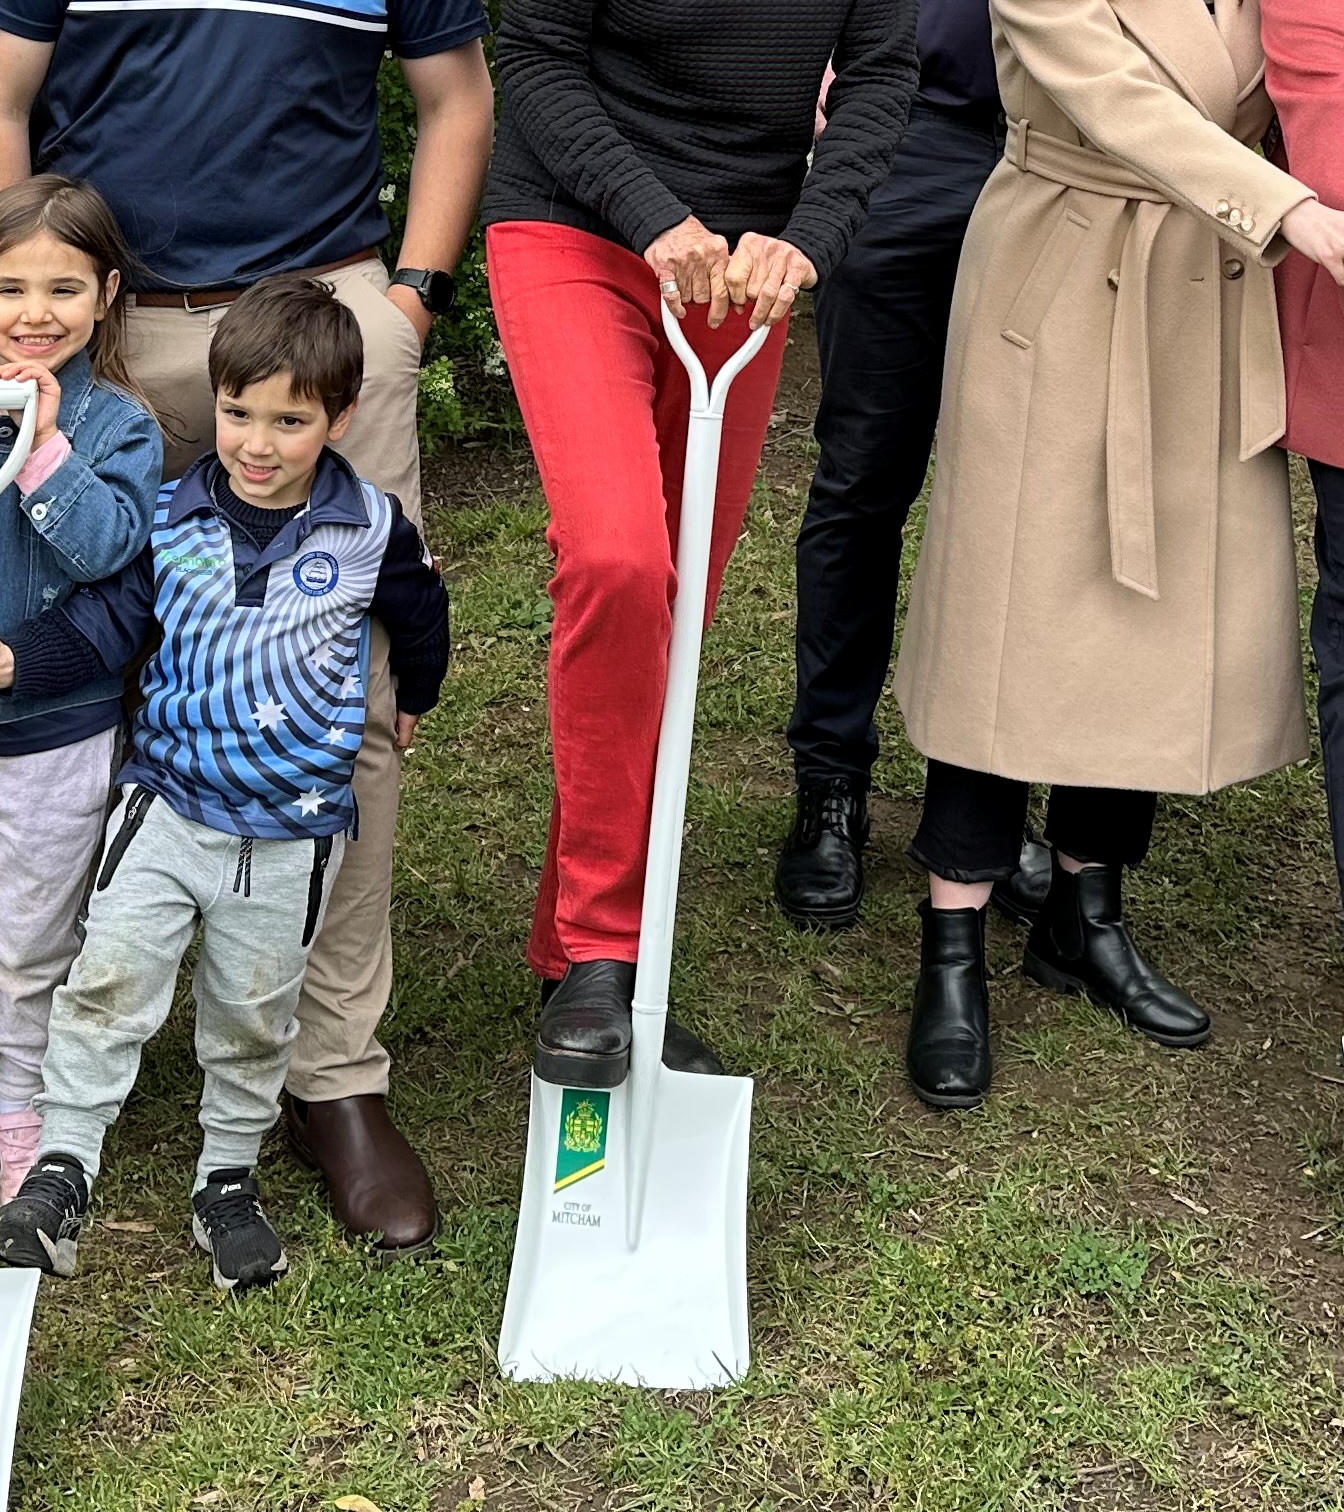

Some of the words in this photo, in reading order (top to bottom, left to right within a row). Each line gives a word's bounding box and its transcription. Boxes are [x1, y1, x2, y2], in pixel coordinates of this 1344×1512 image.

[563, 1202, 580, 1211] CITY
[581, 1203, 592, 1212] OF
[552, 1210, 601, 1227] MITCHAM
